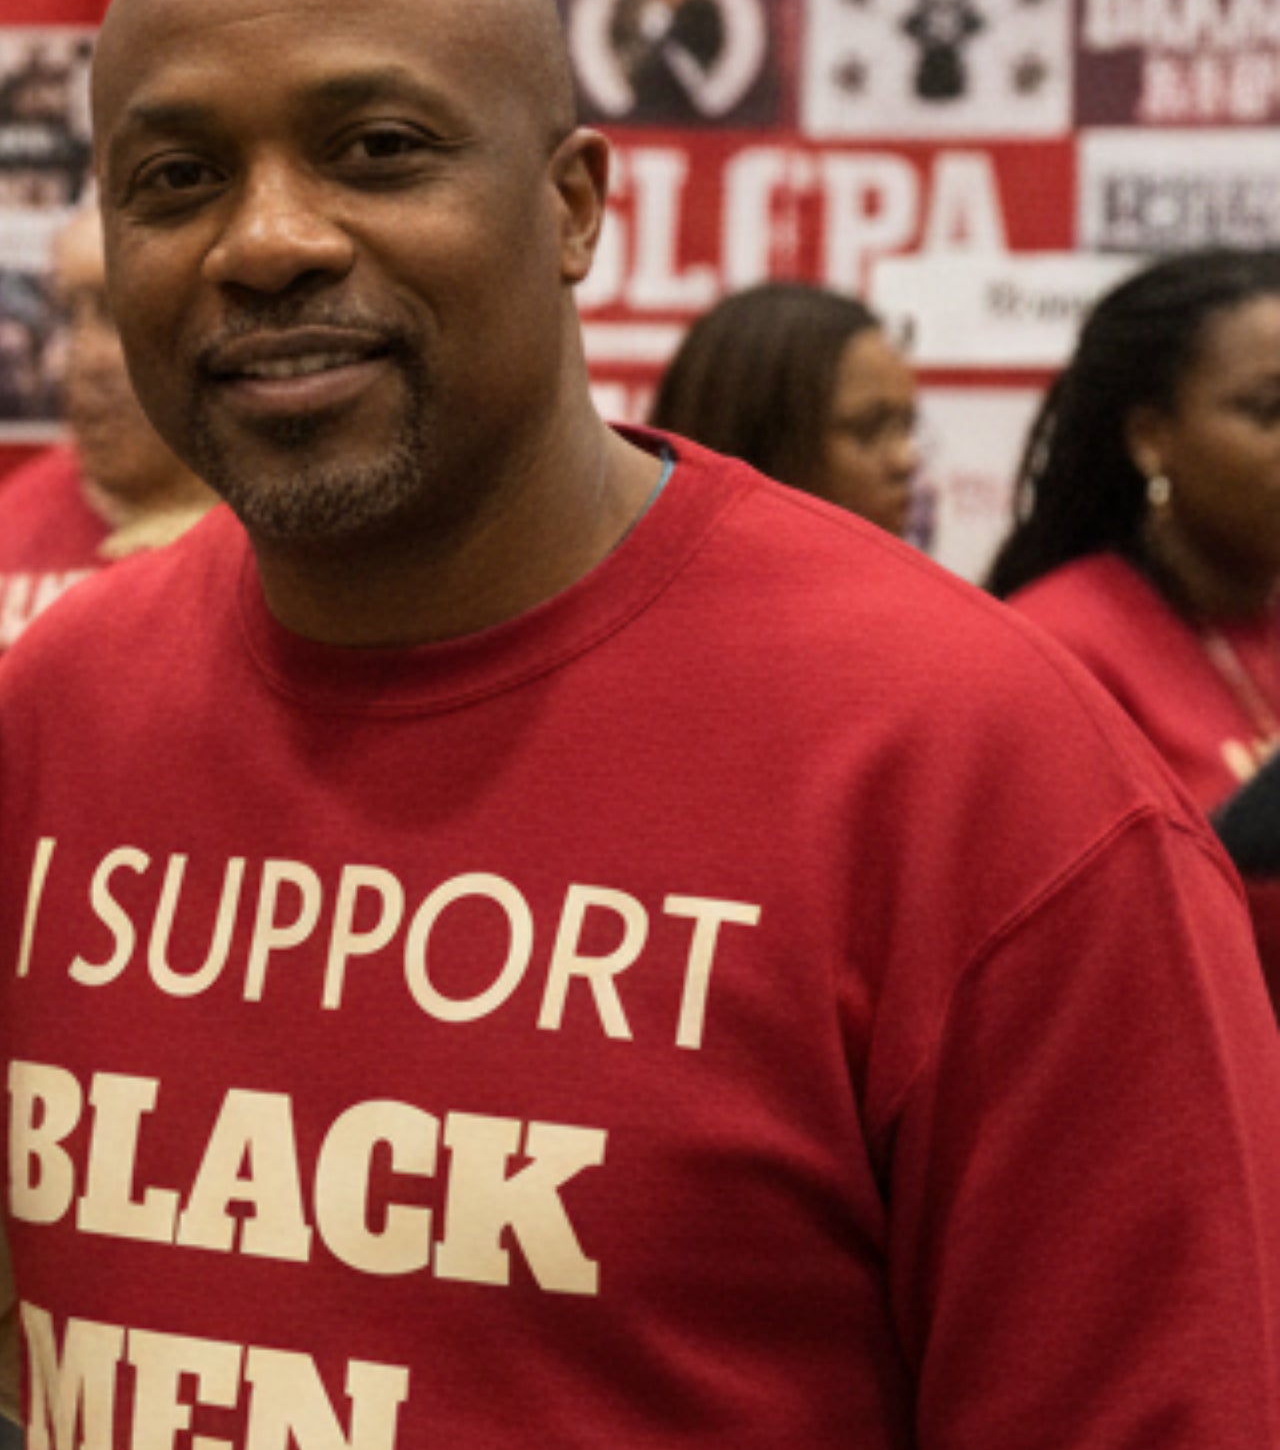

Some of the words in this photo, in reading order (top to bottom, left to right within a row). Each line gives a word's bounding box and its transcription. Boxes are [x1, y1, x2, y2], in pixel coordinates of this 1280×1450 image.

[16, 836, 56, 978] I
[68, 845, 761, 1051] SUPPORT
[7, 1060, 609, 1295] BLACK
